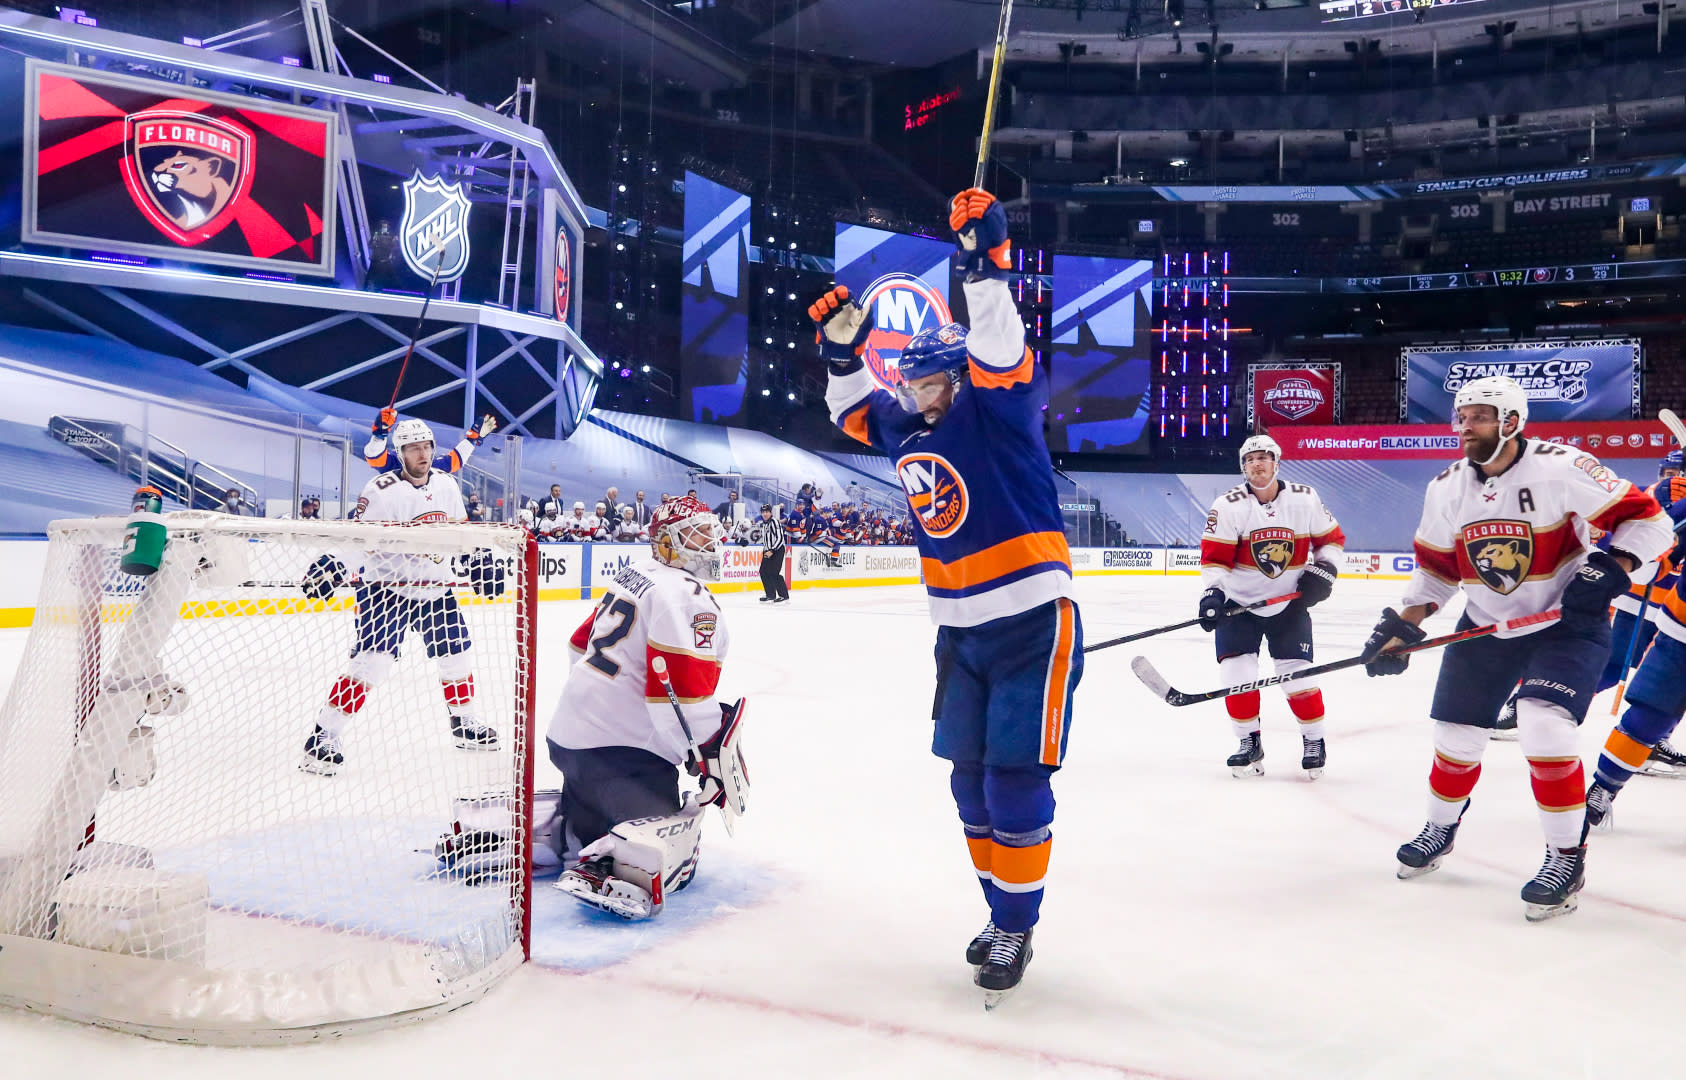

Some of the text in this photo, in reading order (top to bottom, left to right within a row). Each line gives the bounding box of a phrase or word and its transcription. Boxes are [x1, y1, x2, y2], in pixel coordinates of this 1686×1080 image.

[1363, 3, 1373, 14] 2
[145, 126, 231, 154] FLORIDA
[1608, 167, 1631, 175] 2020
[1416, 169, 1588, 193] STANLEY CUP QUALIFIERS
[1513, 194, 1612, 214] BAY STREET
[1450, 205, 1480, 218] 303
[1272, 213, 1300, 226] 302
[415, 208, 457, 256] NHL
[1500, 271, 1523, 281] 9:32
[1565, 267, 1575, 281] 3
[1593, 270, 1607, 280] 29
[1418, 280, 1431, 289] 23
[1448, 275, 1458, 288] 2
[878, 289, 930, 339] NY
[1449, 360, 1592, 379] STANLEY CUP
[1266, 389, 1324, 401] EASTERN
[1564, 383, 1584, 399] NHL
[1298, 437, 1459, 449] #WeSkateFor BLACK LIVES
[900, 459, 936, 505] NY
[1517, 487, 1536, 514] A
[1254, 531, 1292, 540] FLORIDA
[1466, 524, 1525, 540] FLORIDA
[1112, 550, 1153, 560] RIDGEWOOD
[865, 554, 917, 571] EISNERAMPER
[1135, 559, 1153, 567] BANK
[723, 570, 748, 579] WELCOME
[1228, 672, 1294, 695] BAUER
[1525, 677, 1577, 698] BAUER
[655, 818, 695, 839] CCM
